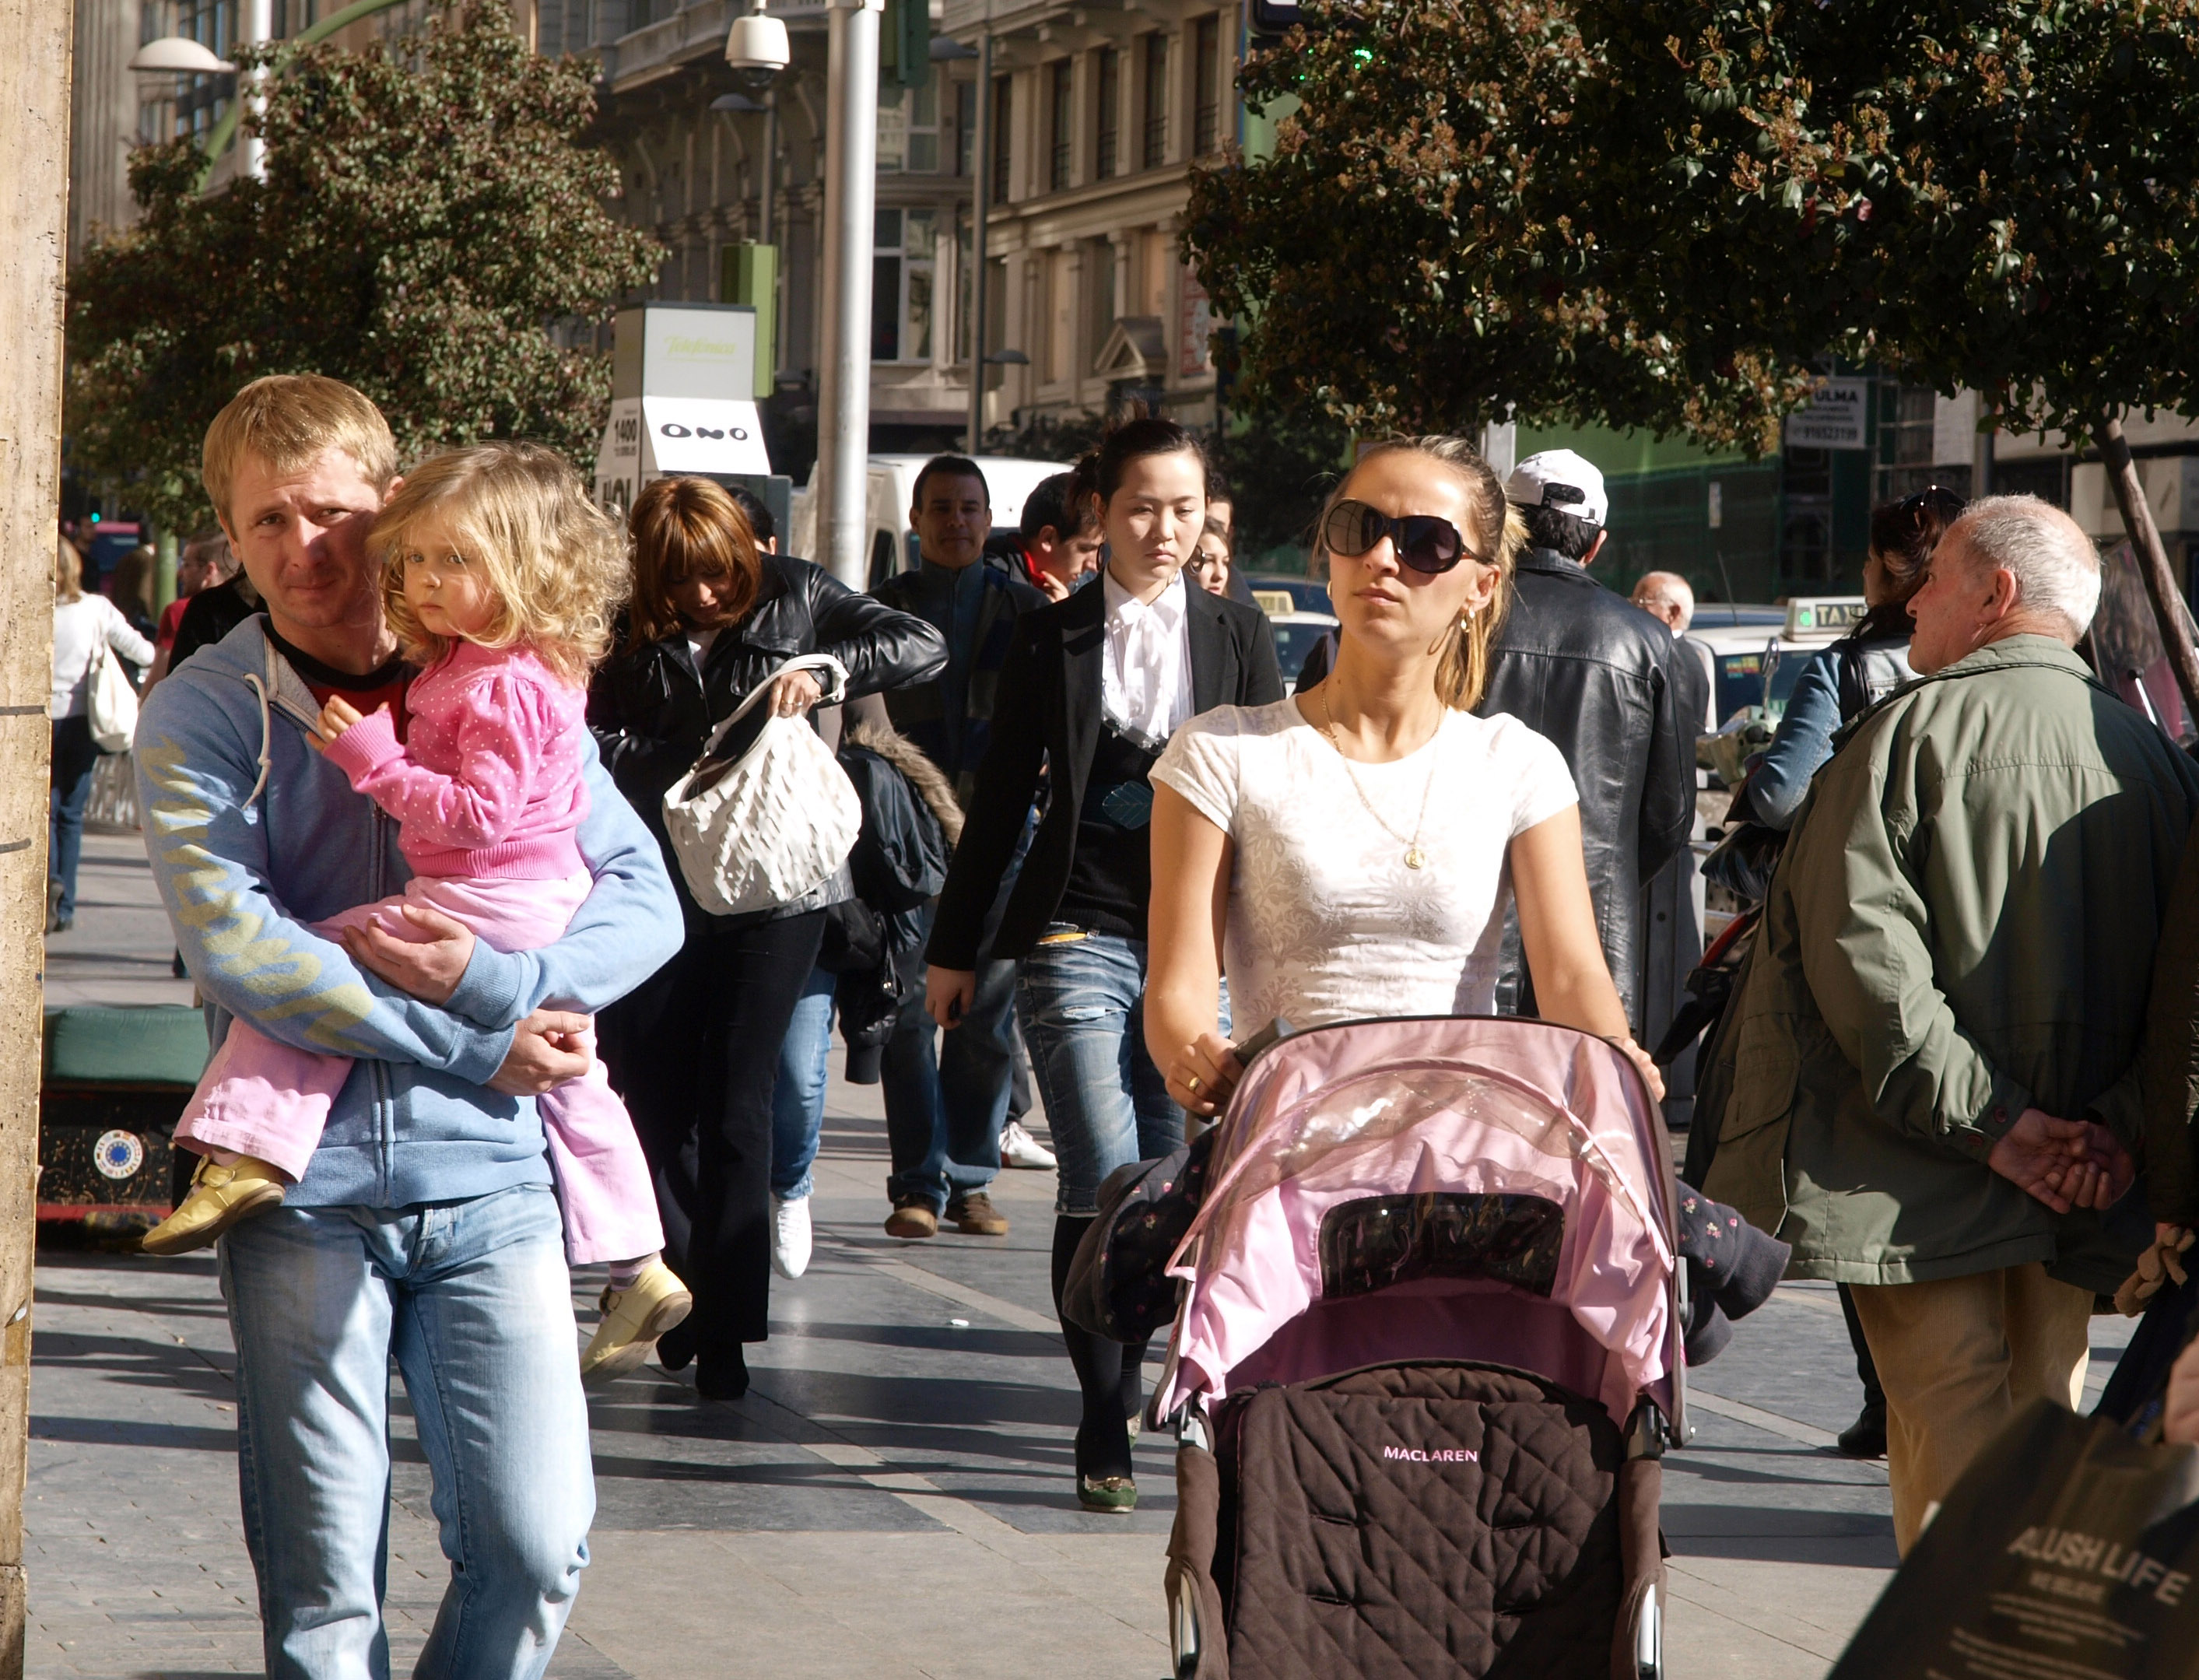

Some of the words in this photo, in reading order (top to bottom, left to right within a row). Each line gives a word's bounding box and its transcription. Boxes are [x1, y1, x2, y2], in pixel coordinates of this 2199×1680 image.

[1814, 388, 1858, 402] ULMA
[615, 418, 637, 444] 1400
[1383, 1445, 1478, 1463] MACLAREN
[2099, 1542, 2192, 1607] LIFE
